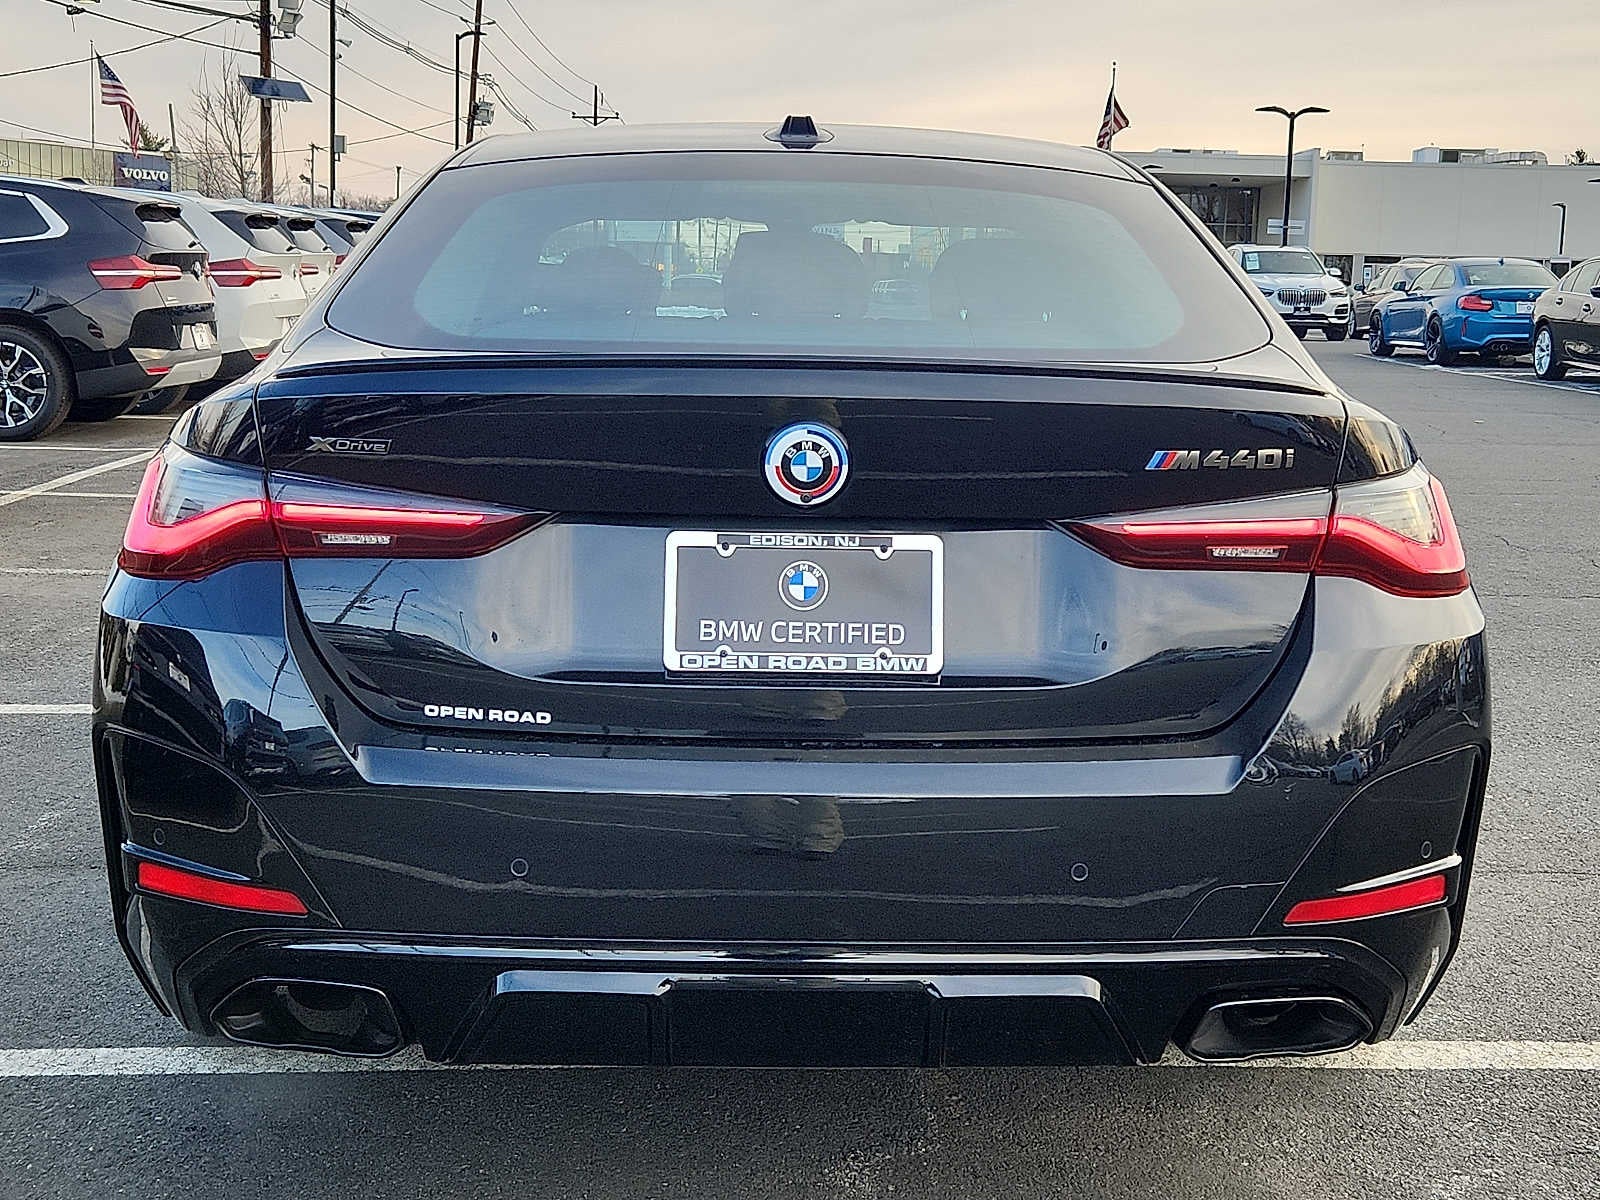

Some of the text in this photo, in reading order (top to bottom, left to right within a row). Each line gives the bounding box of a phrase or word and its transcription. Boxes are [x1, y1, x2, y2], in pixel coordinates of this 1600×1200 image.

[121, 167, 169, 181] VOLVO
[784, 441, 830, 459] BMW
[749, 535, 861, 547] EDISON, NJ
[699, 619, 906, 645] BMW CERTIFIED
[681, 654, 925, 671] OPEN ROAD BMW
[423, 704, 552, 725] OPEN ROAD
